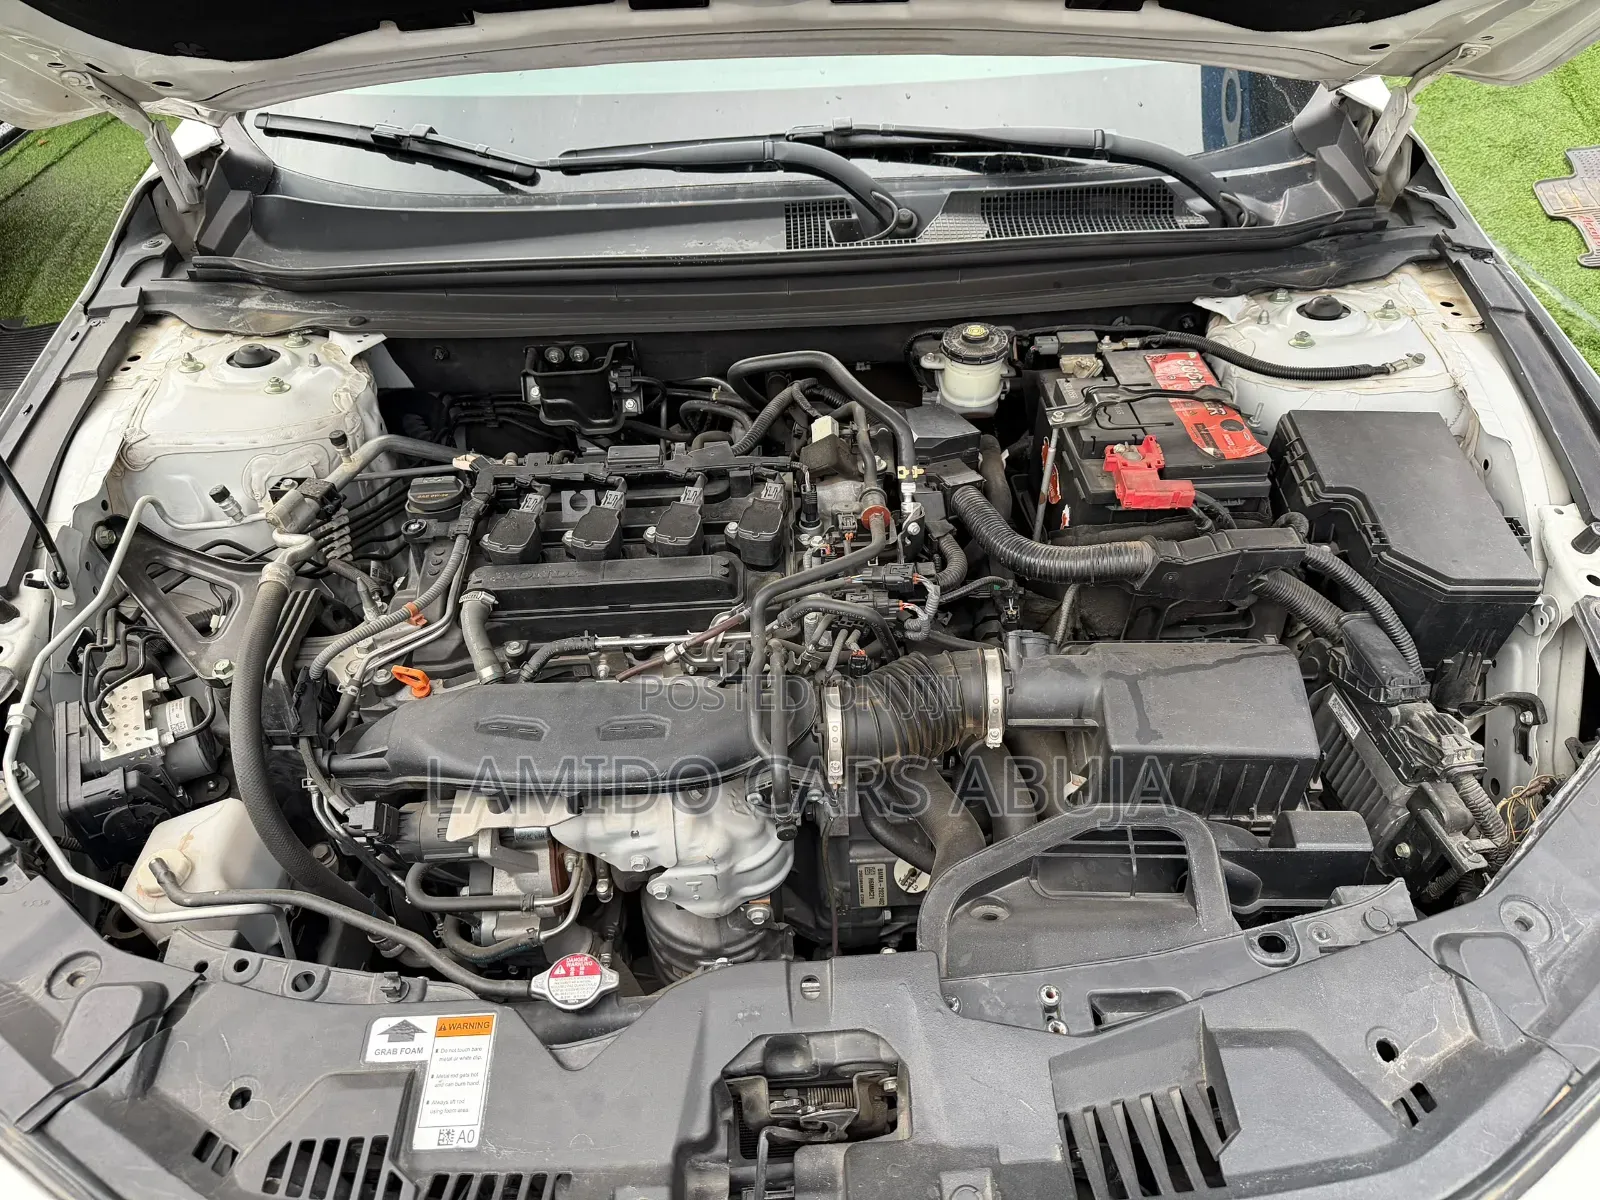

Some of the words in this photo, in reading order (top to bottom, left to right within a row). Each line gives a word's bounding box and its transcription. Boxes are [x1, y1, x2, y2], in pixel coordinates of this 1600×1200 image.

[448, 1021, 491, 1031] WARNING
[374, 1048, 399, 1056] GRAB
[400, 1047, 424, 1055] FOAM
[456, 1129, 475, 1145] A0
